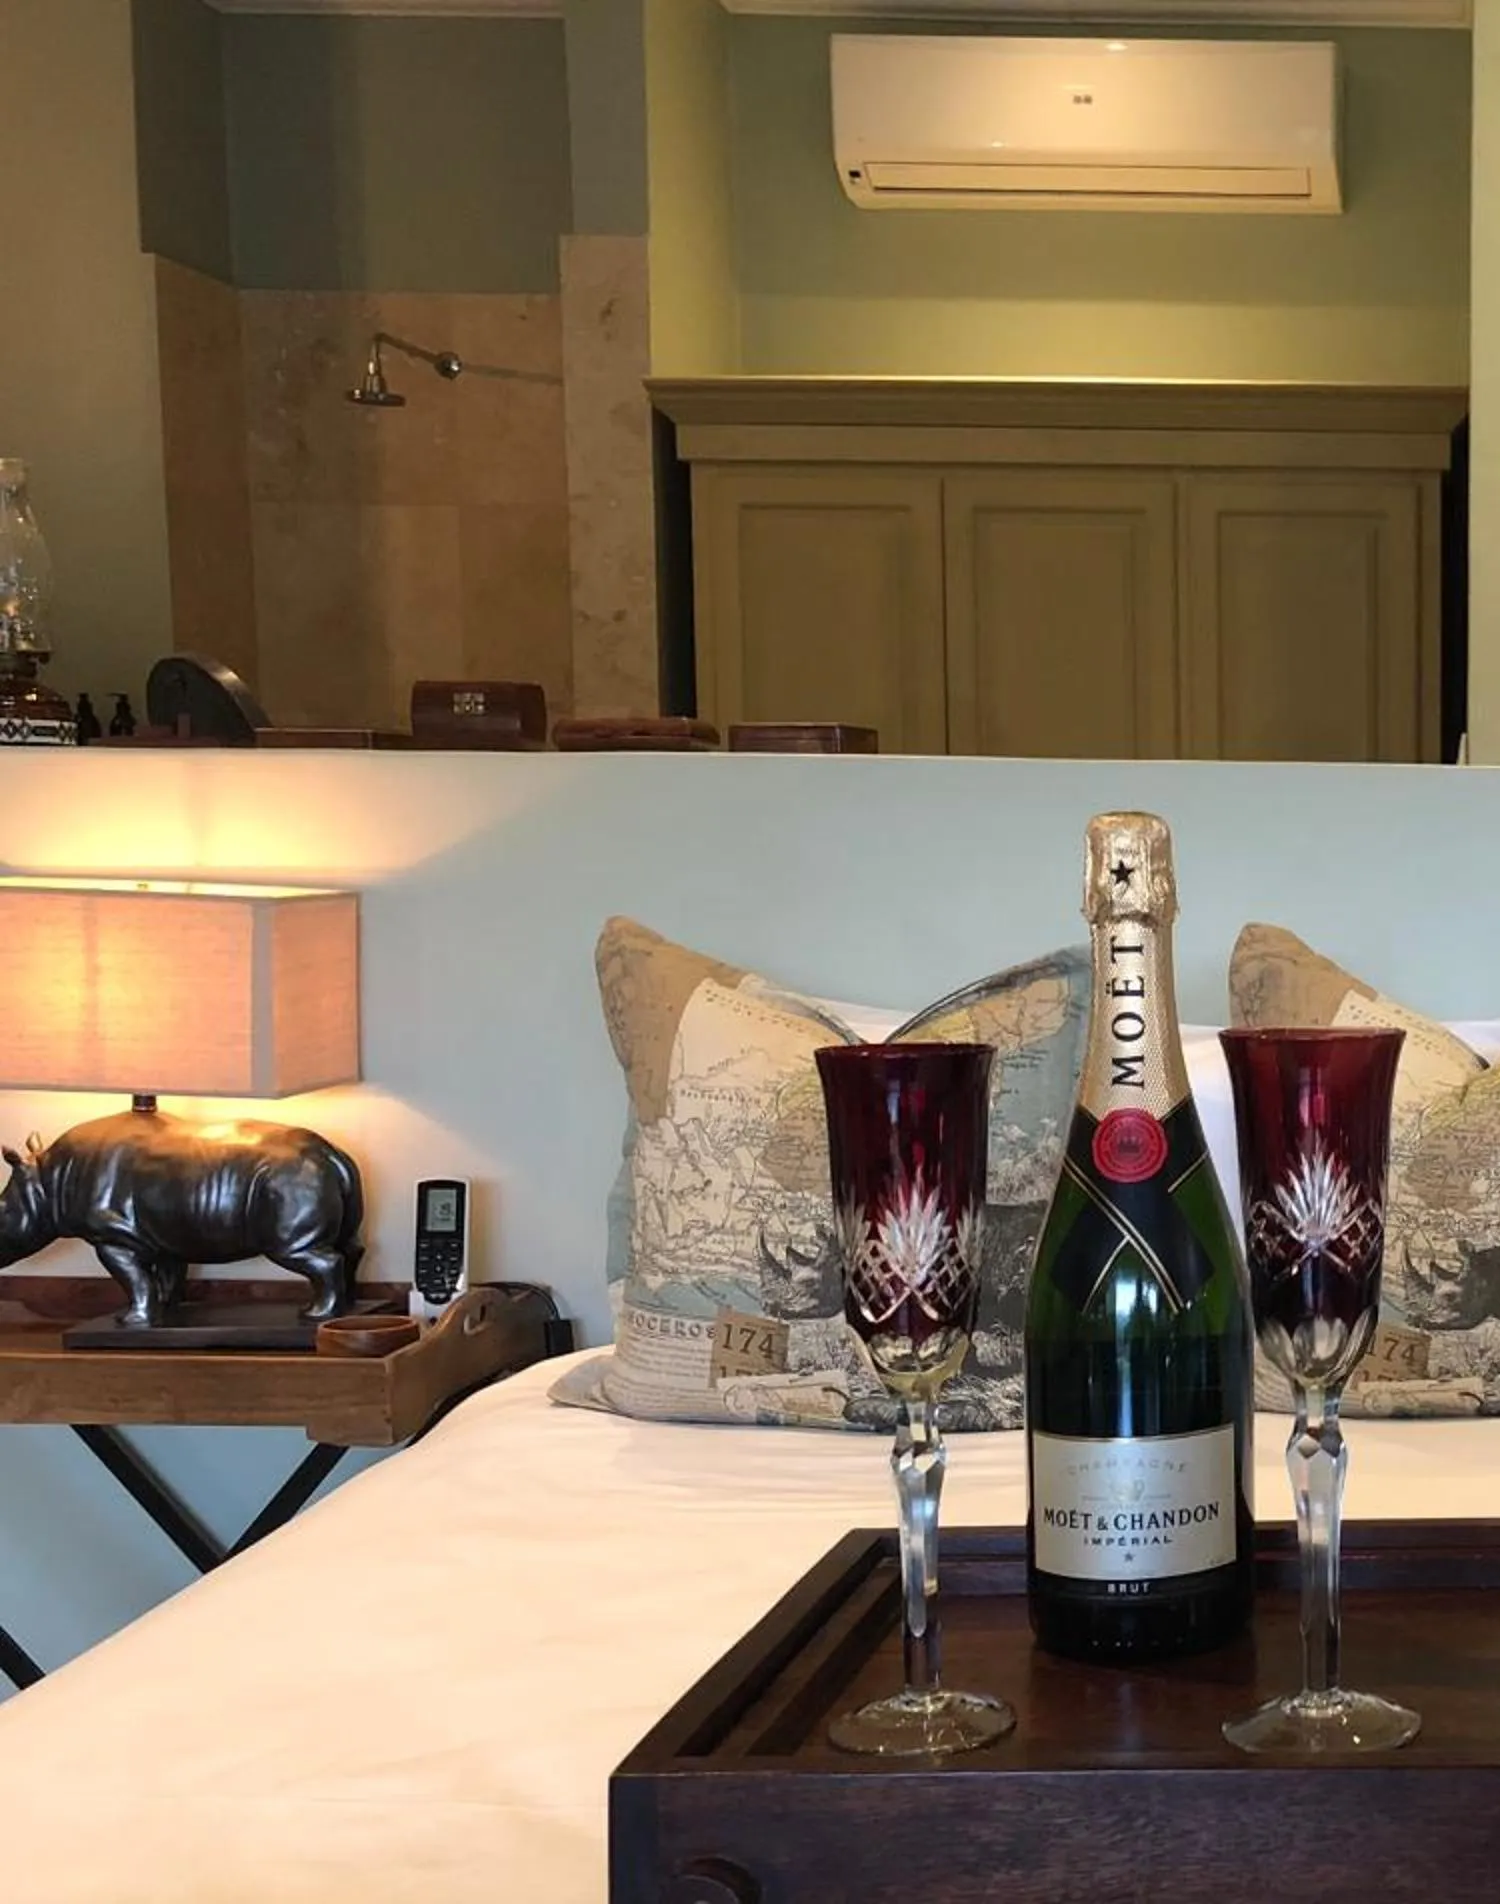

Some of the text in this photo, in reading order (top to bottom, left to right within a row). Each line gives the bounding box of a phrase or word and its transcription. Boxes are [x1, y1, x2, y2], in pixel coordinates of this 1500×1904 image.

[1106, 936, 1146, 1088] MOËT
[722, 1323, 775, 1359] 174
[1097, 1517, 1109, 1531] &
[1113, 1502, 1220, 1531] CHANDON
[1106, 1582, 1151, 1595] BRUT
